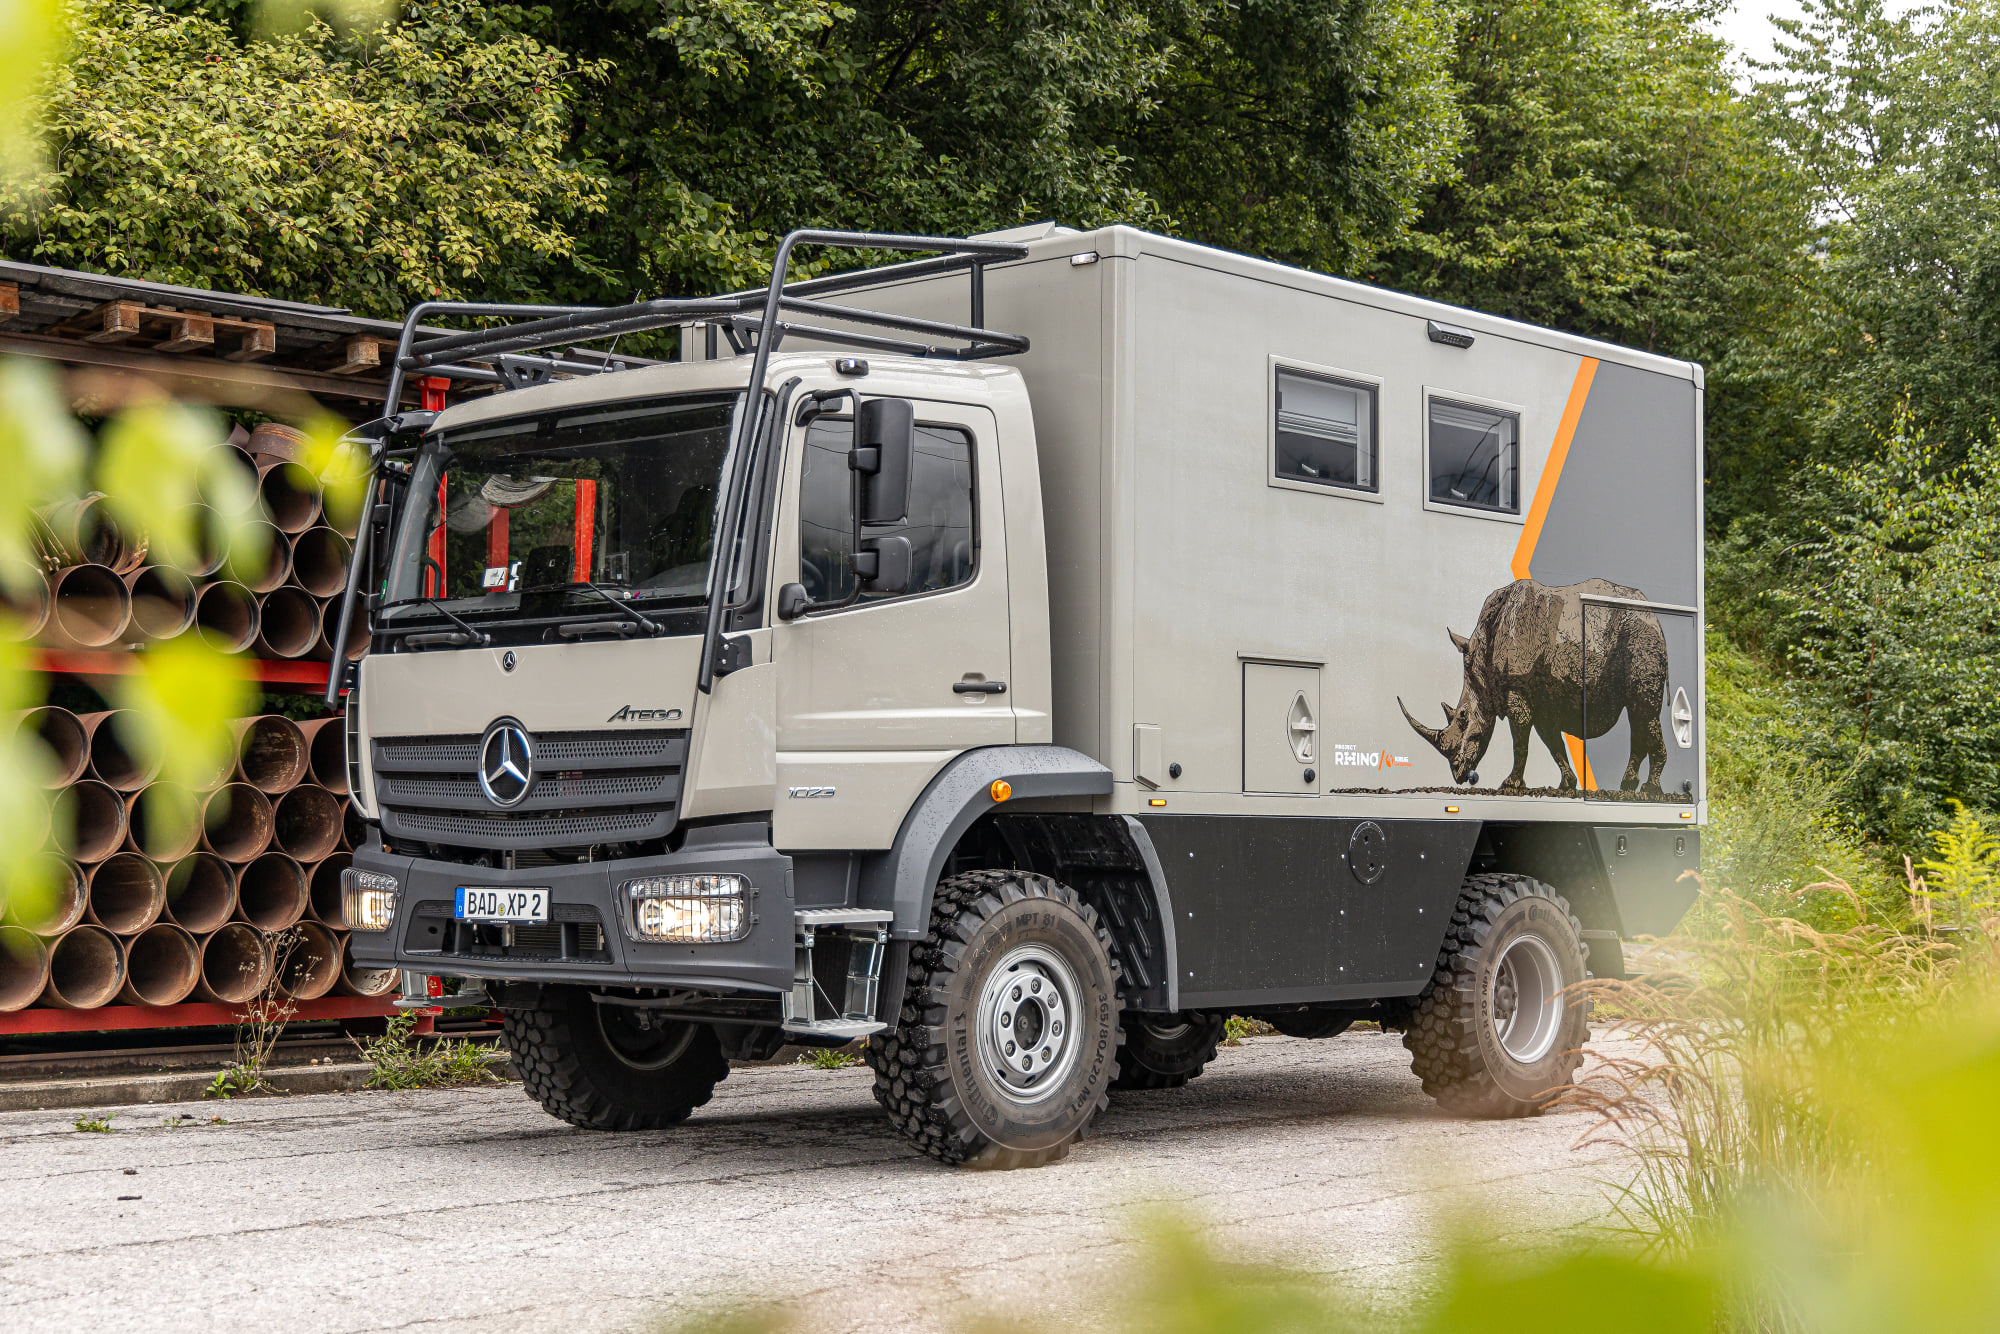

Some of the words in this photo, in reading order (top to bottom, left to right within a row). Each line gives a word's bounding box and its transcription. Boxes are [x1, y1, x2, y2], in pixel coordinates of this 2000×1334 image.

[607, 704, 683, 723] ATEGO
[1335, 752, 1379, 766] RHINO
[789, 786, 836, 799] 1023
[458, 905, 463, 913] D
[467, 891, 497, 915] BAD
[506, 893, 527, 916] XP
[531, 893, 541, 917] 2
[1015, 912, 1040, 929] MPT
[1042, 913, 1056, 928] 81
[1481, 967, 1491, 997] MPT
[1480, 999, 1488, 1018] 20
[1097, 992, 1110, 1051] 365/80
[1093, 1051, 1105, 1065] R
[953, 1027, 999, 1126] Continental
[1087, 1064, 1101, 1086] 20
[1070, 1085, 1091, 1118] MPT
